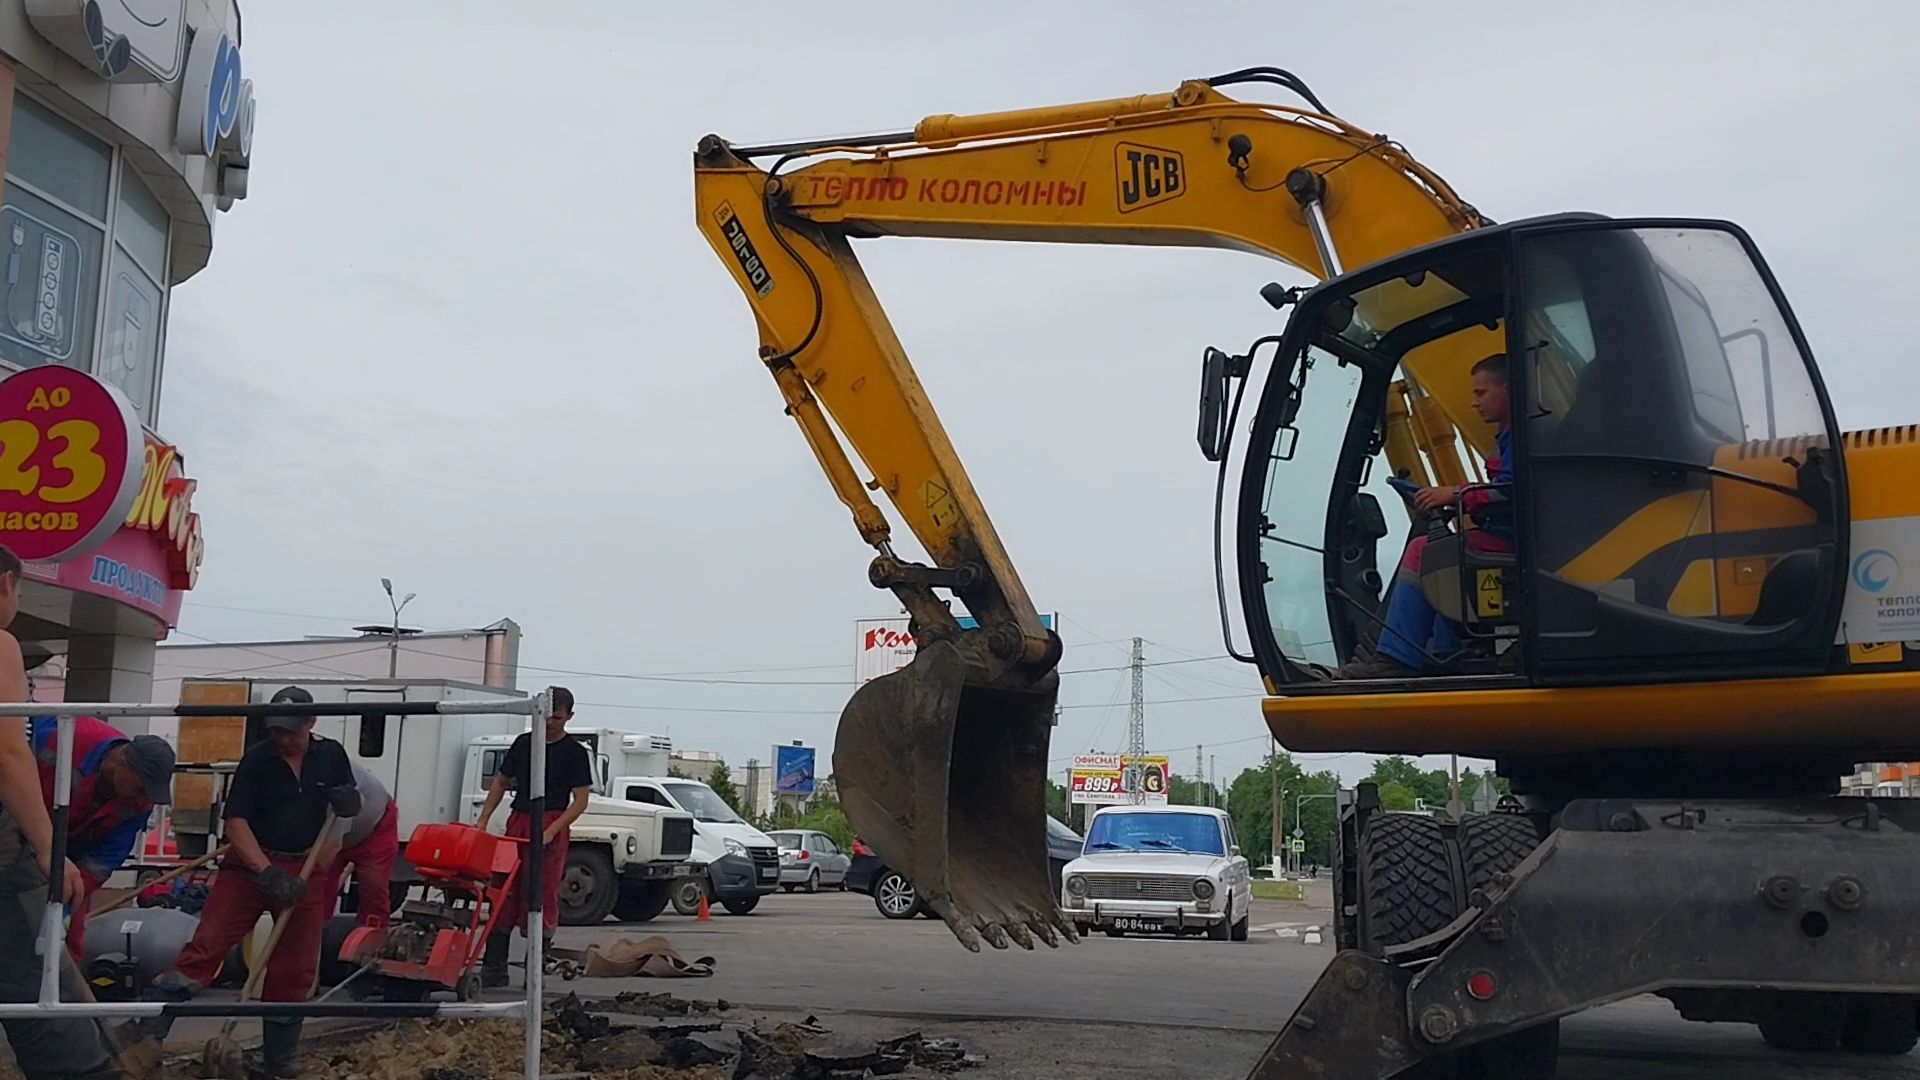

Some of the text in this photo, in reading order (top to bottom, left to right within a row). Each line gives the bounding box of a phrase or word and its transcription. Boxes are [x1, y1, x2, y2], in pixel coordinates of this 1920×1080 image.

[918, 178, 1087, 207] КОЛОМНЫ
[1122, 150, 1179, 205] JCB
[0, 419, 106, 503] 23
[1074, 756, 1117, 765] ОФИСМАГ
